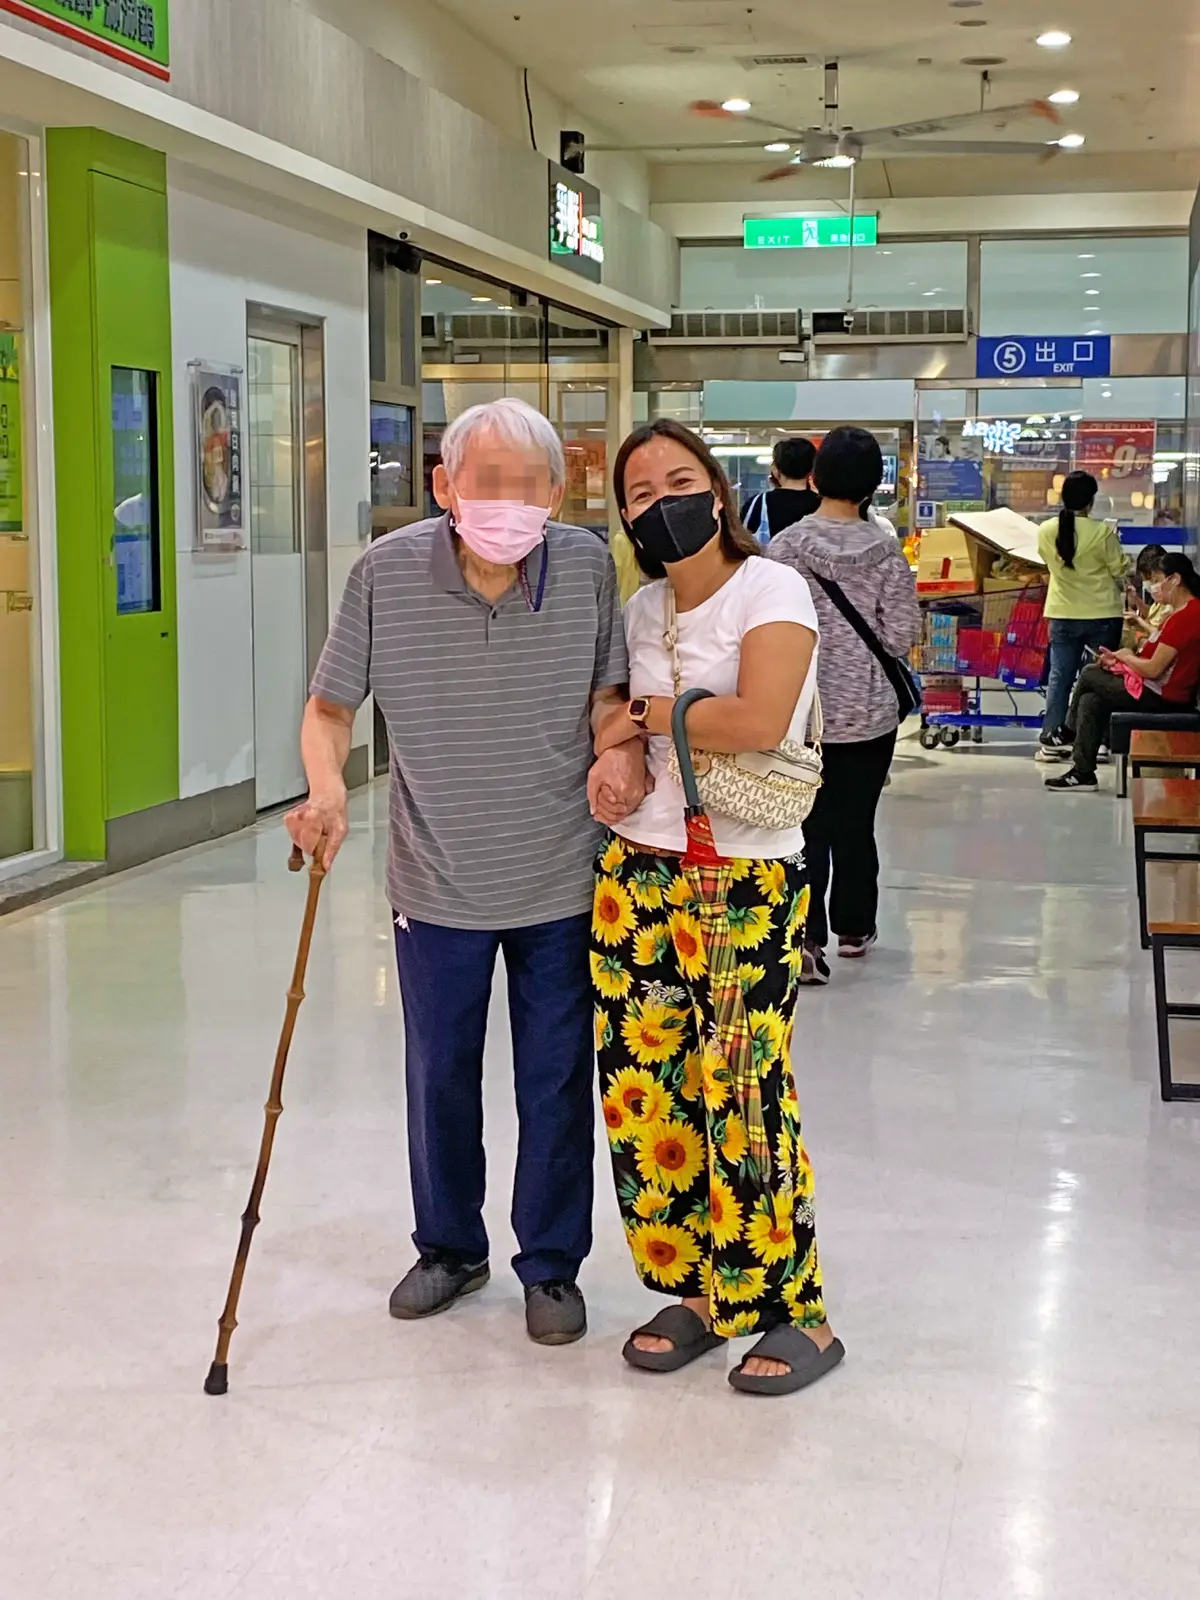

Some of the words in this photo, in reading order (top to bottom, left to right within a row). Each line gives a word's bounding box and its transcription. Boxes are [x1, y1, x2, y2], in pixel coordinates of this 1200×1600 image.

[757, 235, 790, 245] EXIT
[1035, 341, 1094, 362] 出口
[1053, 362, 1075, 373] EXIT
